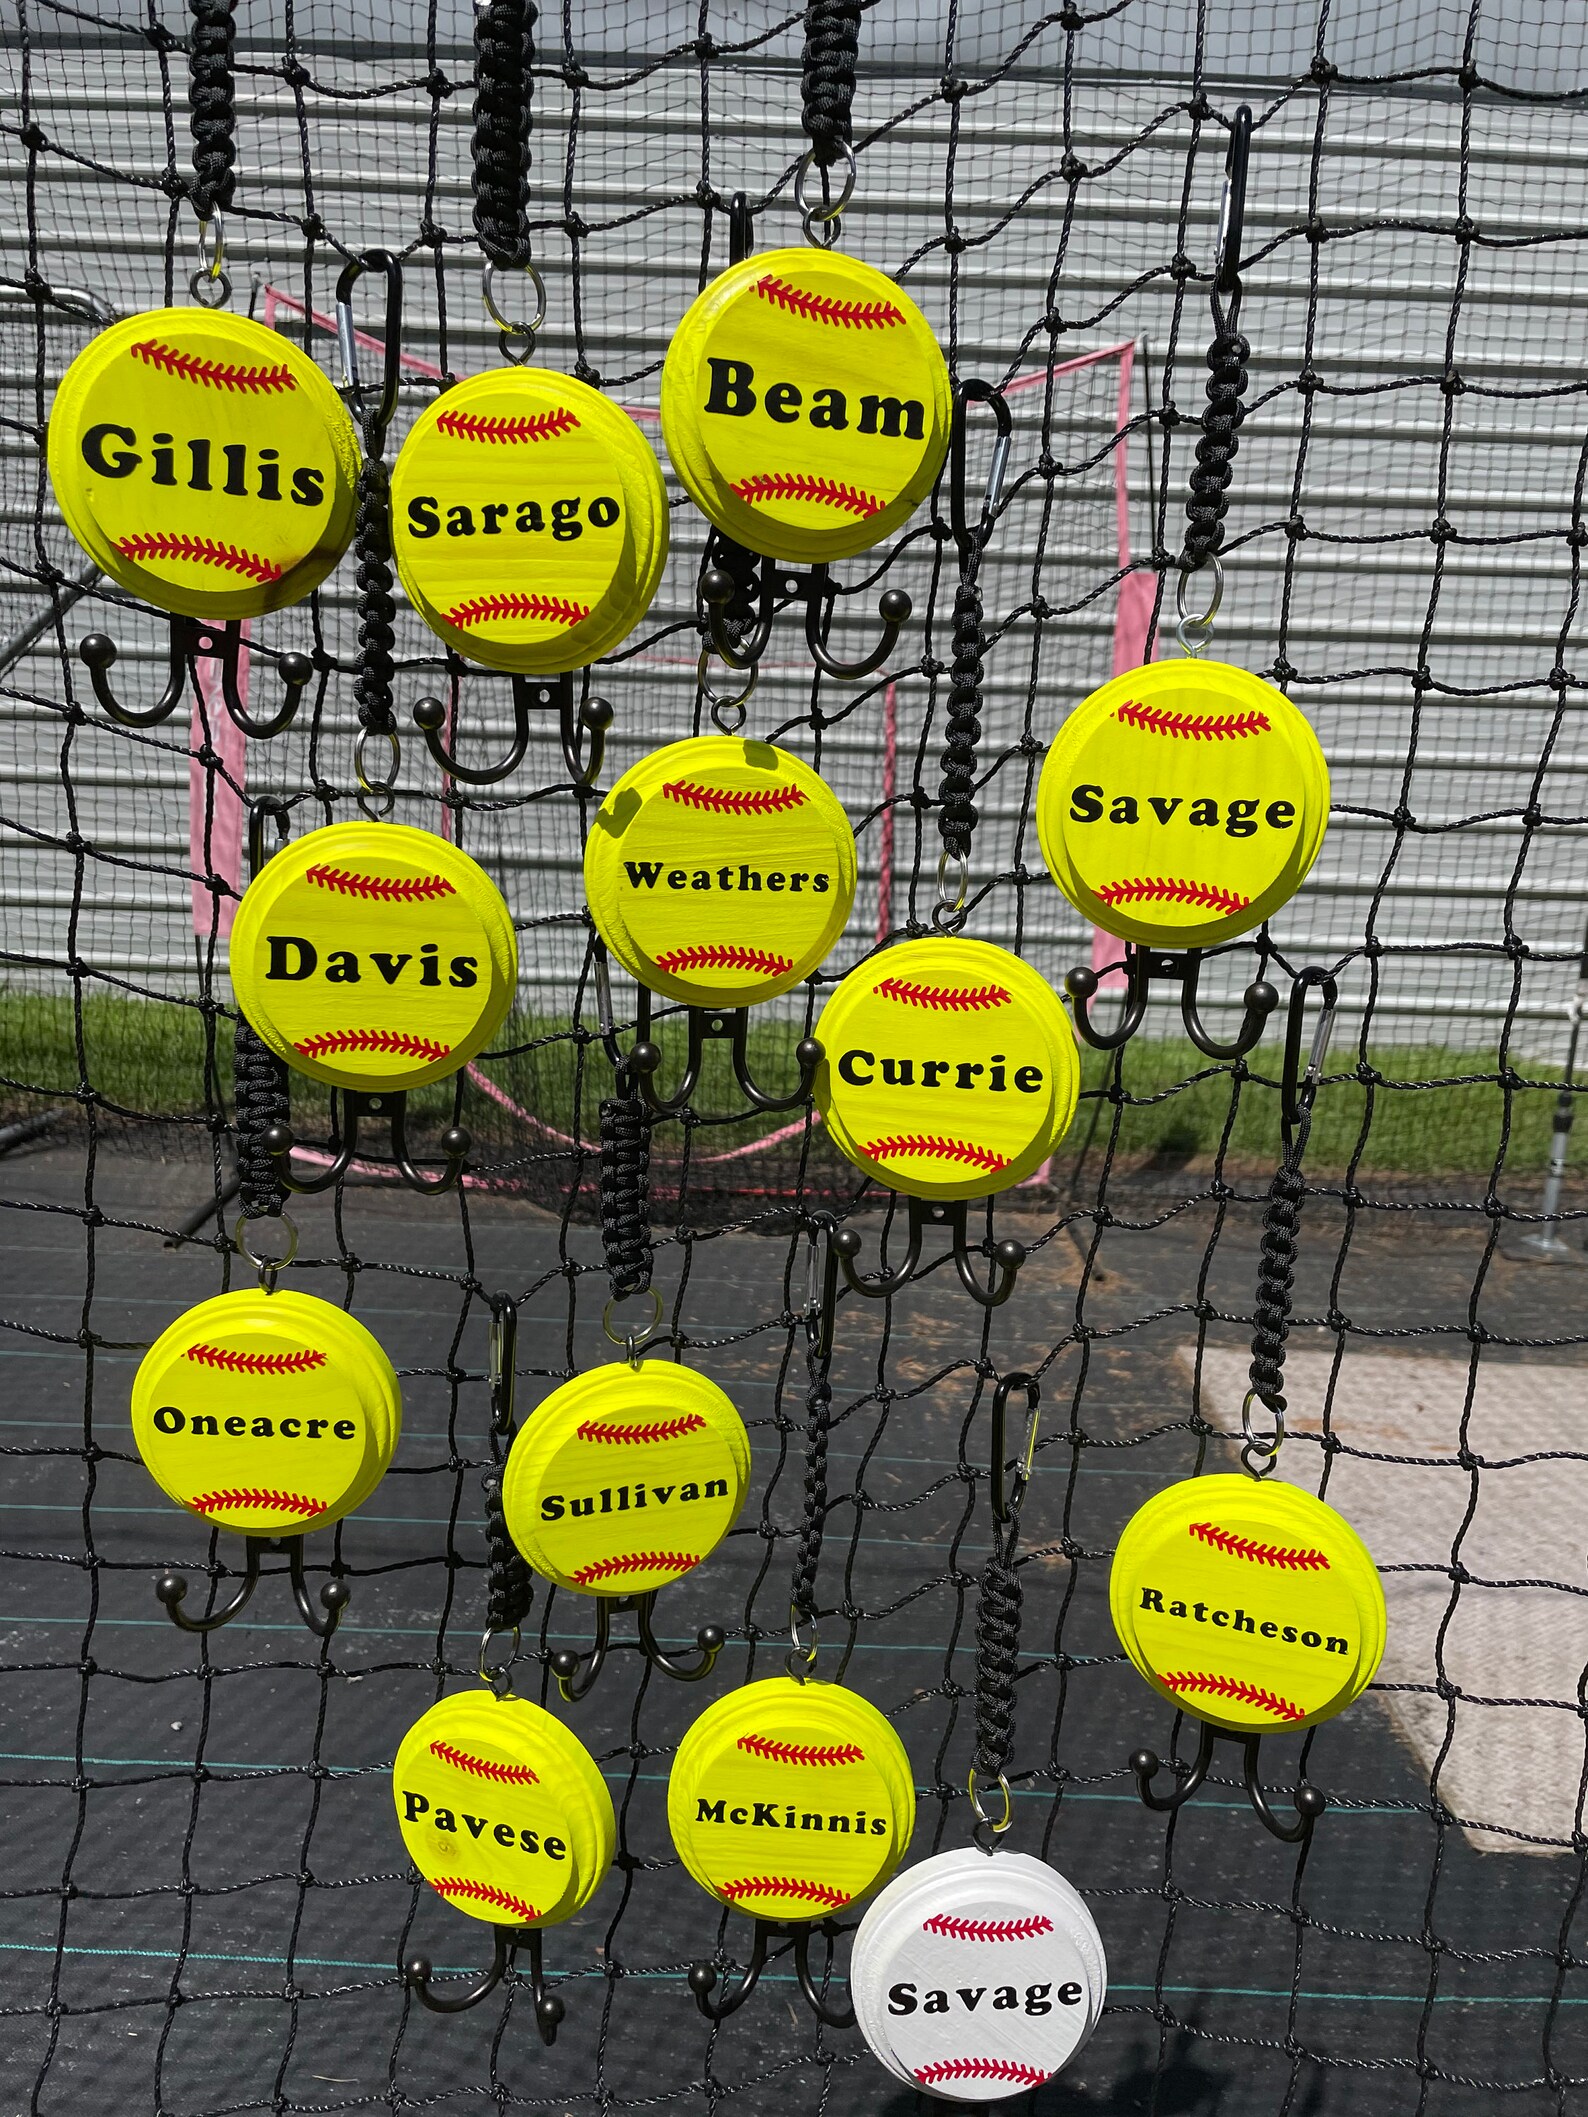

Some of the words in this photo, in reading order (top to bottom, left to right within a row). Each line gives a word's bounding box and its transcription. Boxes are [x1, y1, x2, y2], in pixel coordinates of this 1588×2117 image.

[704, 357, 925, 440] Beam
[82, 424, 325, 507] Gillis
[407, 496, 620, 542] Sarago
[1069, 784, 1296, 838] Savage
[624, 861, 830, 893] Weathers
[266, 936, 478, 988] Davis
[838, 1049, 1043, 1094] Currie
[153, 1406, 356, 1440] Oneacre
[541, 1478, 729, 1521] Sullivan
[1139, 1587, 1349, 1655] Ratcheson
[402, 1790, 567, 1861] Pavese
[696, 1798, 887, 1836] McKinnis
[887, 1981, 1083, 2017] Savage
